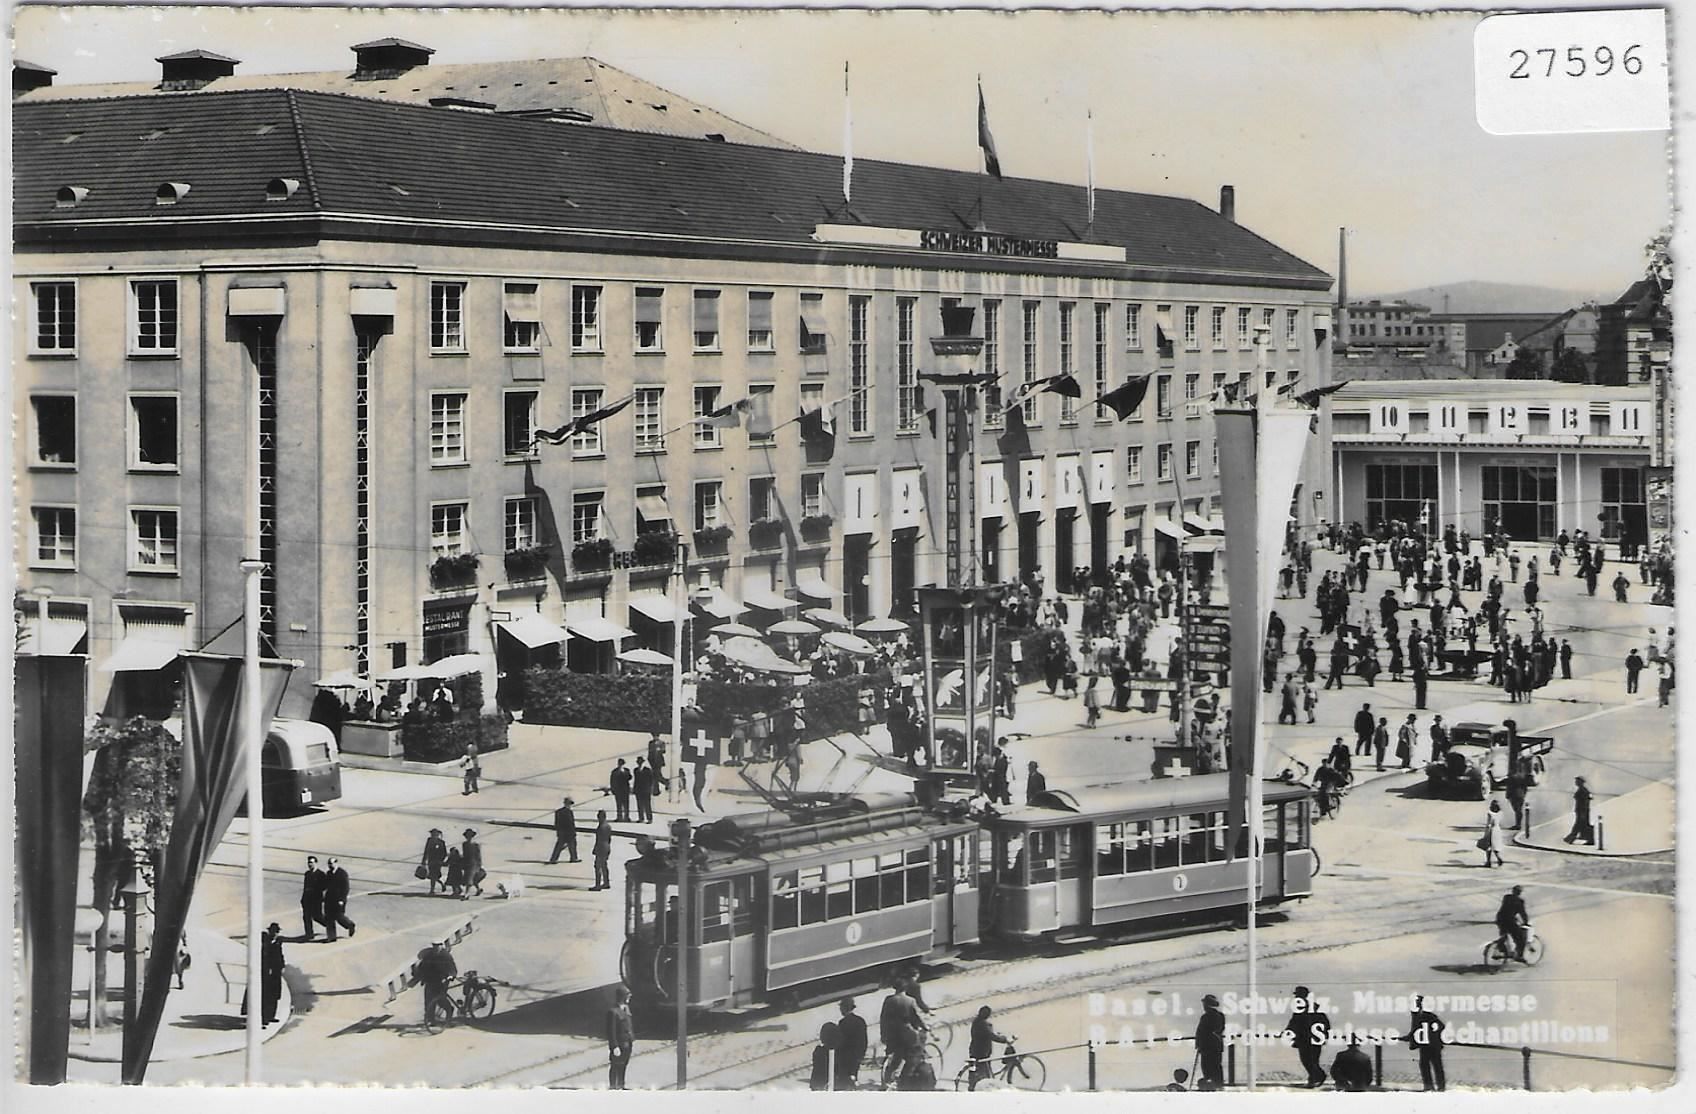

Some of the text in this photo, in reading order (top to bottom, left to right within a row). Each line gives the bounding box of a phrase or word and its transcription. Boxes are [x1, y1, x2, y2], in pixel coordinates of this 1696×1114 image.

[1509, 44, 1643, 79] 27596
[920, 230, 1059, 259] SCHWEIZER MUSTERMESSE
[1381, 405, 1398, 428] 10
[1441, 406, 1456, 429] 11
[1500, 406, 1517, 429] 12
[1561, 407, 1578, 430] 13
